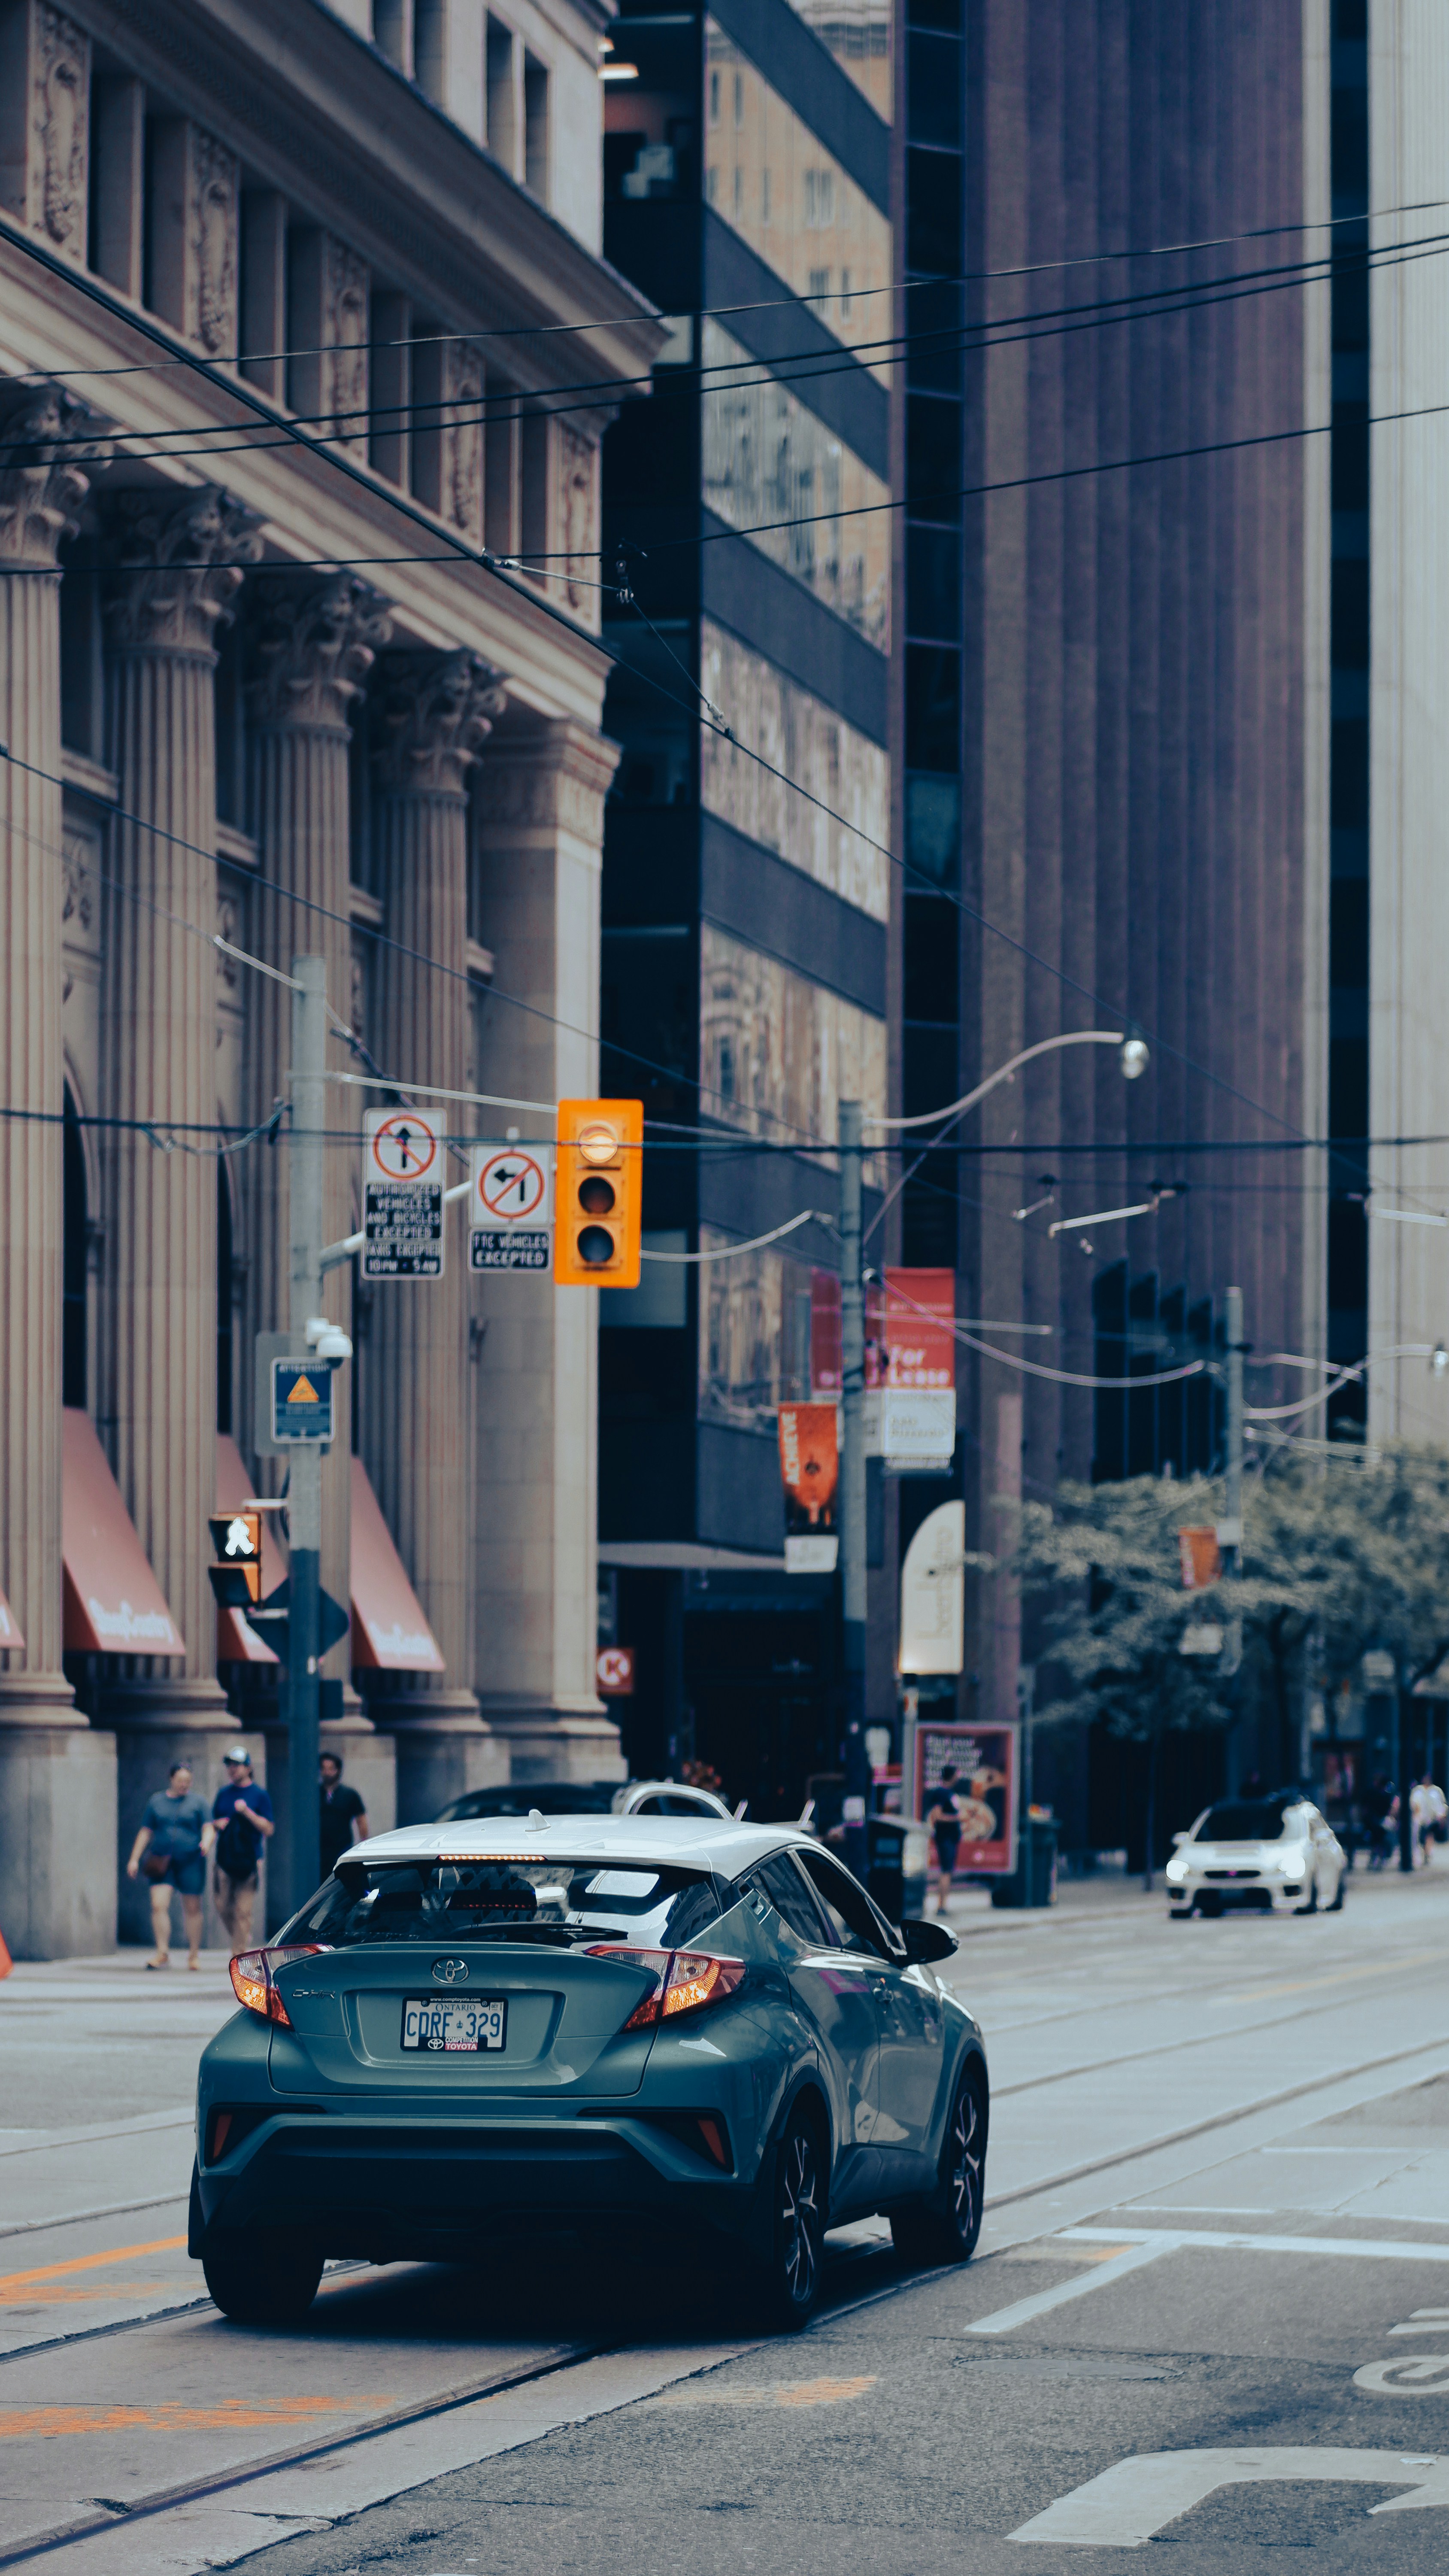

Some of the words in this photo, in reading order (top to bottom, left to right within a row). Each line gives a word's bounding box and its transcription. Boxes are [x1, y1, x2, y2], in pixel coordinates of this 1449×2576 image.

[377, 1197, 430, 1210] VEHICLES
[368, 1212, 387, 1224] AND
[394, 1212, 440, 1224] BICYCLES
[375, 1226, 431, 1238] EXCEPTED
[475, 1235, 493, 1248] TTC
[499, 1235, 548, 1248] VEHICLES
[476, 1251, 544, 1265] EXCEPTED
[890, 1347, 925, 1366] For
[889, 1367, 949, 1385] Lease
[781, 1411, 800, 1485] ACHIEVE
[435, 2004, 476, 2012] ONTARIO
[466, 2013, 500, 2038] 329
